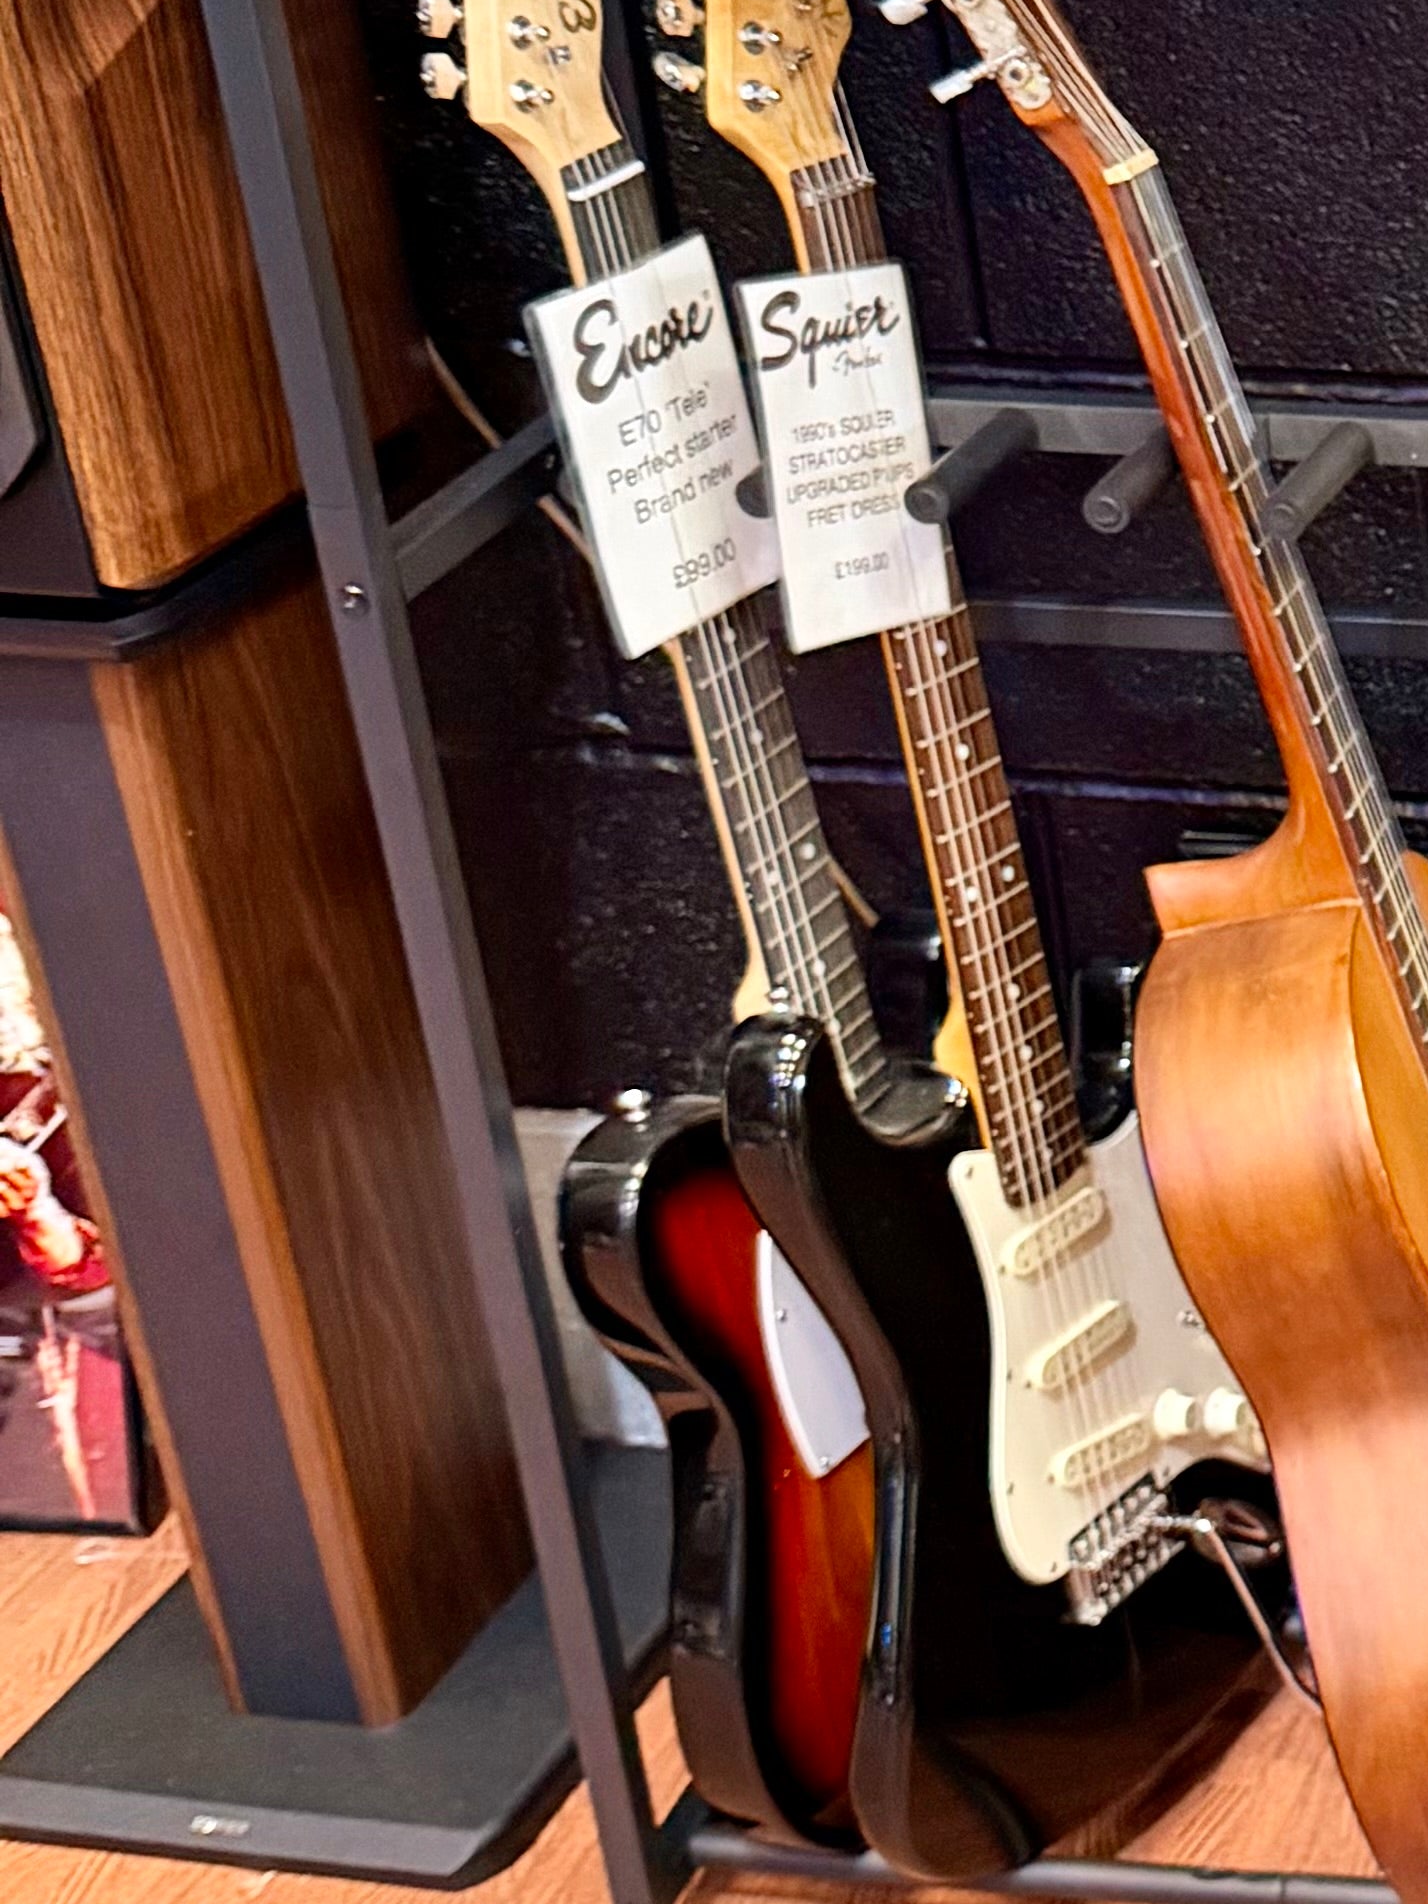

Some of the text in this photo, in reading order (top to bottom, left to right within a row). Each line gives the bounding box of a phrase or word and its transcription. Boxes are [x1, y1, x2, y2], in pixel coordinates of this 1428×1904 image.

[573, 297, 714, 405] Encore
[760, 290, 900, 390] Squier
[606, 413, 739, 495] Perfect starter
[618, 408, 662, 448] E70
[788, 435, 906, 476] STRATOCASTER
[634, 457, 734, 525] Brand new
[785, 469, 871, 506] UPGRADED
[806, 502, 847, 528] FRET
[671, 536, 737, 590] £99.00
